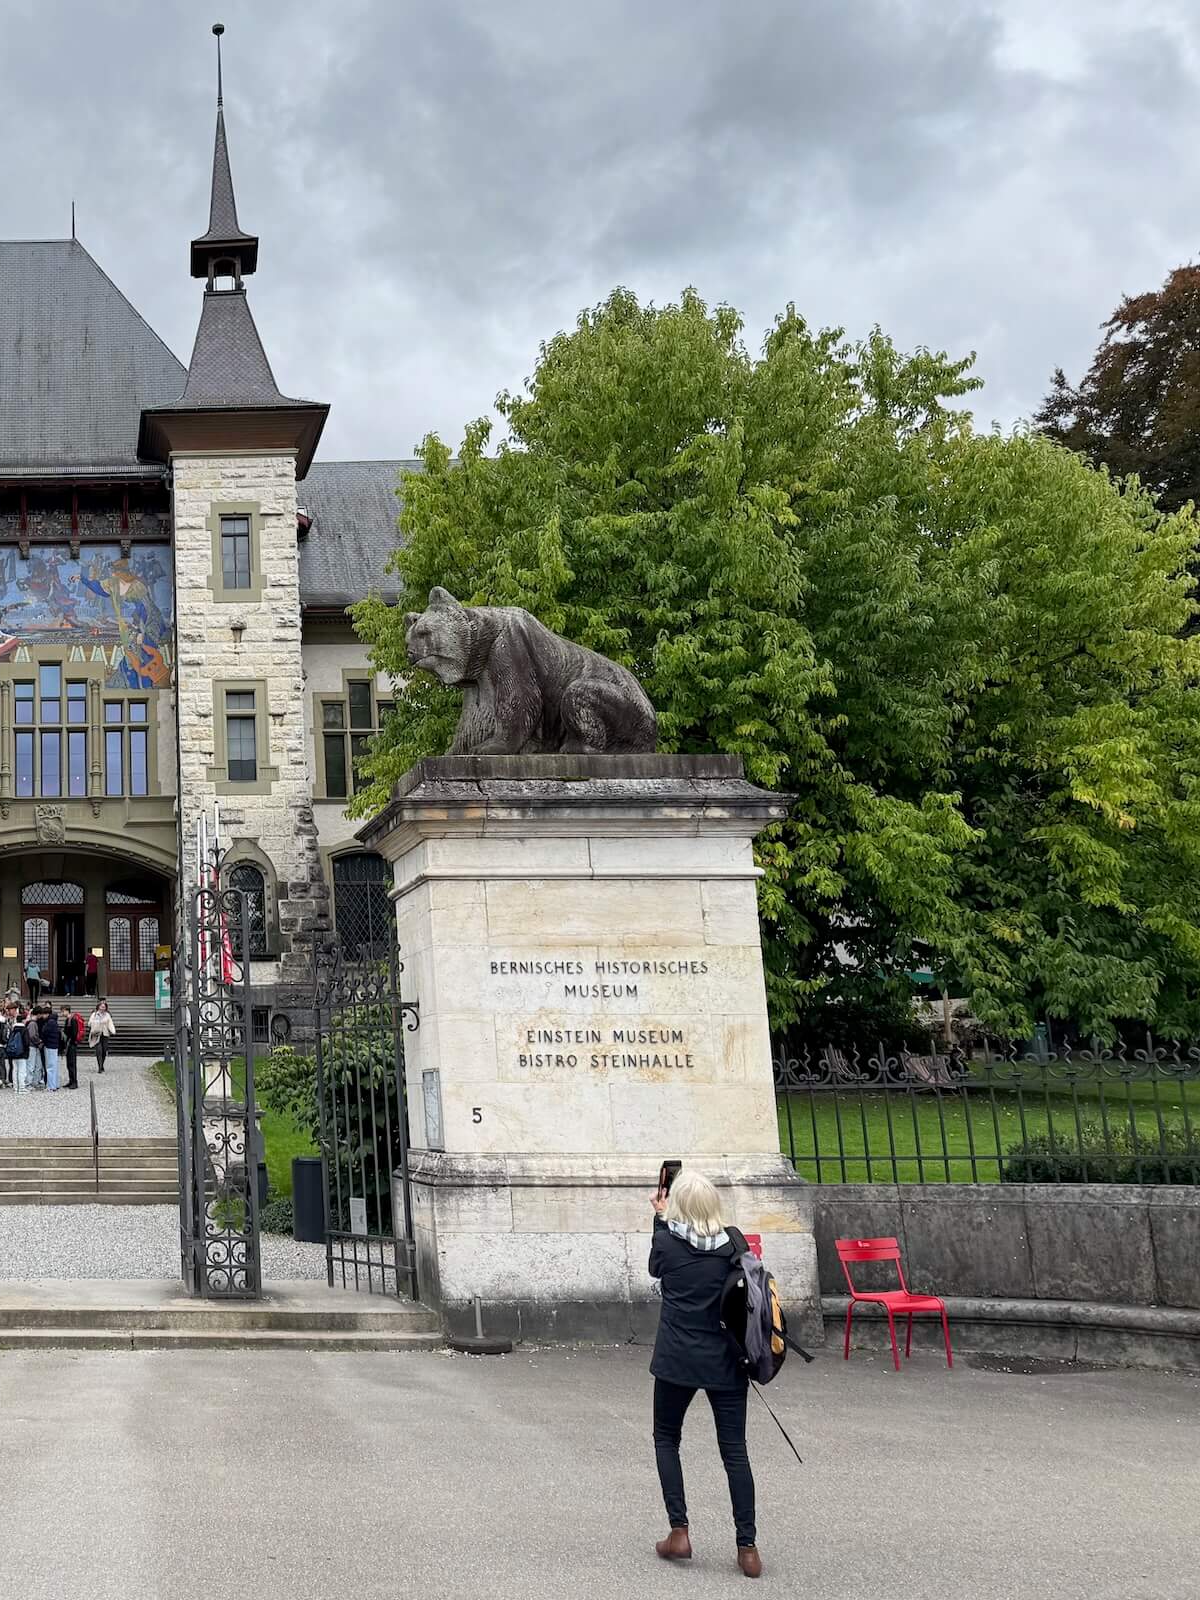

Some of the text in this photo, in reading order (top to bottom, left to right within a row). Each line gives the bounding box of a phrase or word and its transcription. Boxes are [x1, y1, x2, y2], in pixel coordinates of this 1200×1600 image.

[489, 960, 709, 975] BERNISCHES HISTORISCHES
[564, 984, 638, 999] MUSEUM
[526, 1029, 684, 1044] EINSTEIN MUSEUM
[518, 1053, 695, 1069] BISTRO STEINHALLE
[471, 1106, 483, 1124] 5
